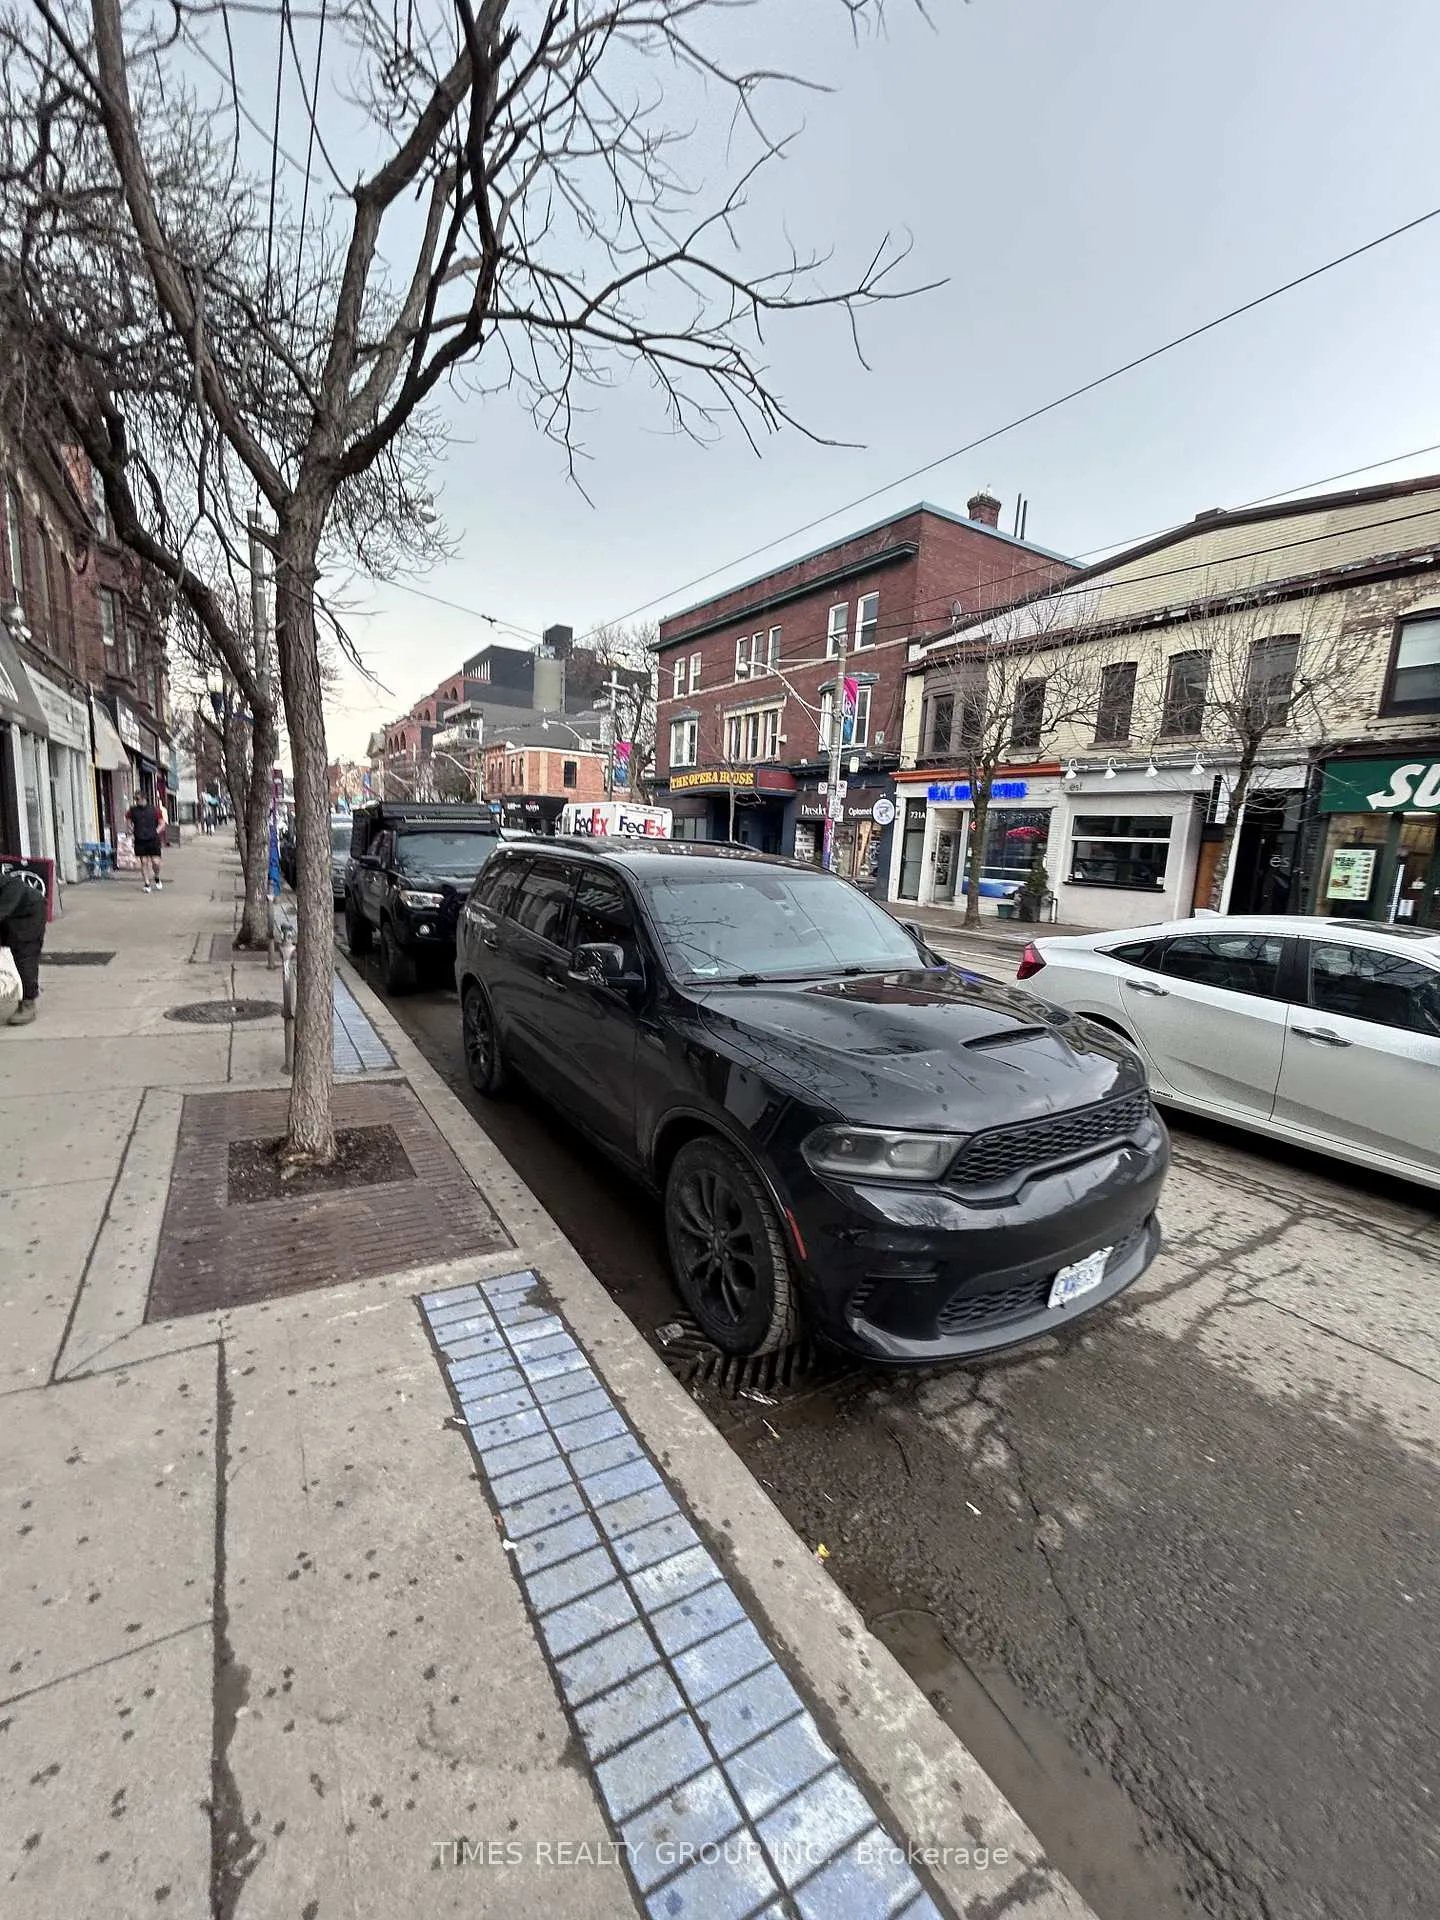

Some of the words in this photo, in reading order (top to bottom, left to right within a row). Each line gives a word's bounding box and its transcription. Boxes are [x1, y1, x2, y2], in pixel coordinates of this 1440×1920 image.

[672, 776, 688, 789] THE
[688, 771, 719, 786] OPERA
[719, 771, 754, 785] HOUSE
[573, 808, 609, 837] FedEx
[619, 815, 667, 838] FedEx
